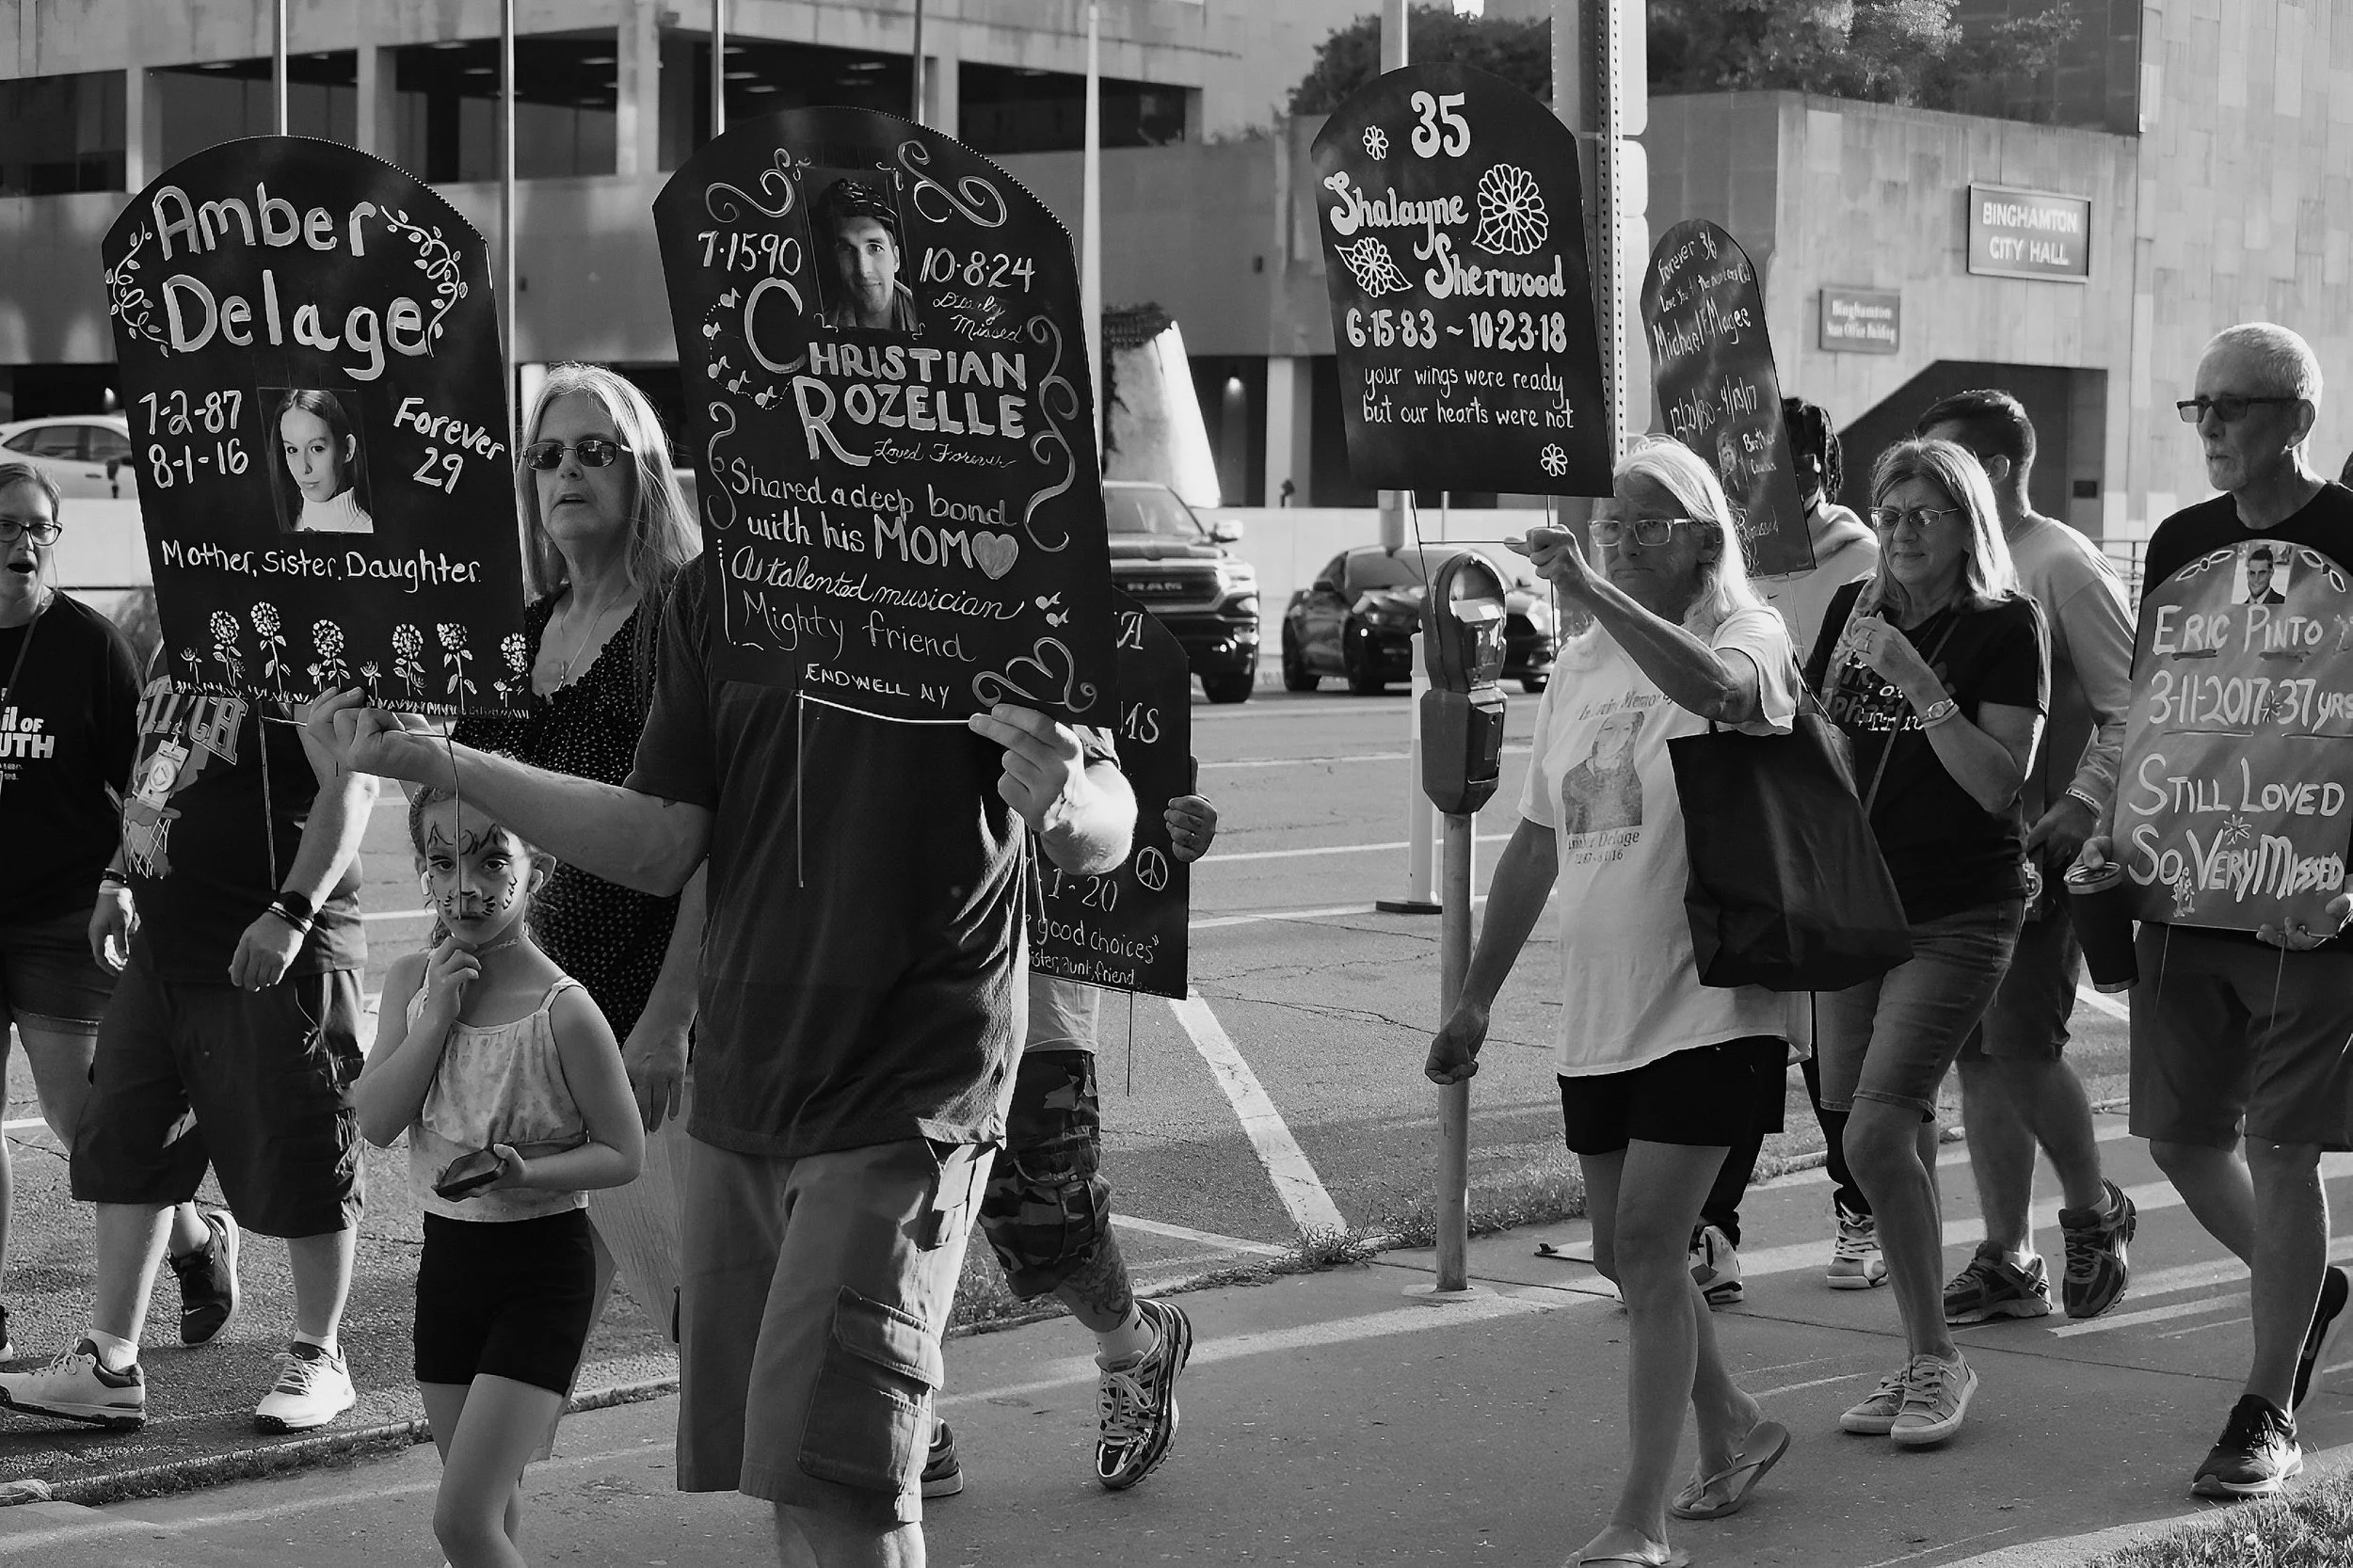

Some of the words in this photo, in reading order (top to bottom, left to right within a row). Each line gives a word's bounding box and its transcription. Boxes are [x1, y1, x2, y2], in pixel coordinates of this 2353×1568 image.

[1410, 90, 1471, 159] 35
[152, 181, 376, 262] Amber
[1323, 170, 1469, 261] Shalayne
[1982, 201, 2079, 233] BINGHAMTON
[1424, 232, 1567, 299] Sherwood
[1989, 236, 2025, 261] CITY
[2029, 239, 2070, 265] HALL
[161, 269, 429, 381] Delage
[744, 277, 1028, 392] CHRISTIAN
[1652, 309, 1705, 366] Michael
[1705, 296, 1752, 345] Magee
[138, 390, 242, 435] 7-2-87
[1362, 394, 1393, 424] but
[1400, 405, 1429, 424] our
[1436, 395, 1489, 424] hearts
[1495, 408, 1539, 428] were
[1545, 398, 1575, 429] not
[1365, 365, 1402, 401] your
[1414, 365, 1459, 399] wings
[1465, 368, 1506, 387] were
[1513, 362, 1564, 409] ready
[393, 396, 505, 461] Forever
[792, 376, 1028, 467] ROZELLE
[148, 438, 248, 488] 8-1-16
[412, 447, 464, 494] 29
[873, 438, 924, 465] Loved
[731, 456, 826, 505] Shared
[832, 488, 848, 507] a
[850, 483, 914, 527] deep
[928, 483, 1016, 528] bond
[161, 538, 258, 578] Mother,
[746, 505, 813, 546] with
[820, 510, 865, 553] his
[873, 513, 974, 570] MOM
[761, 555, 874, 601] talented
[873, 586, 1025, 621] musician
[1128, 582, 1183, 592] RAM
[743, 589, 844, 661] Mighty
[861, 609, 976, 662] friend
[2152, 604, 2231, 656] ERIC
[2243, 604, 2324, 653] PINTO
[804, 663, 911, 697] ENDWELL
[920, 683, 951, 710] NY
[2148, 669, 2271, 726] 3-11-2017
[2278, 678, 2316, 728] 37
[20, 717, 44, 733] OF
[2127, 753, 2232, 817] STILL
[2240, 755, 2346, 817] LOVED
[2127, 823, 2184, 887] SO
[2185, 828, 2259, 904] VERY
[2251, 833, 2345, 900] MISSED
[1035, 919, 1085, 946] good
[1094, 960, 1135, 985] friend
